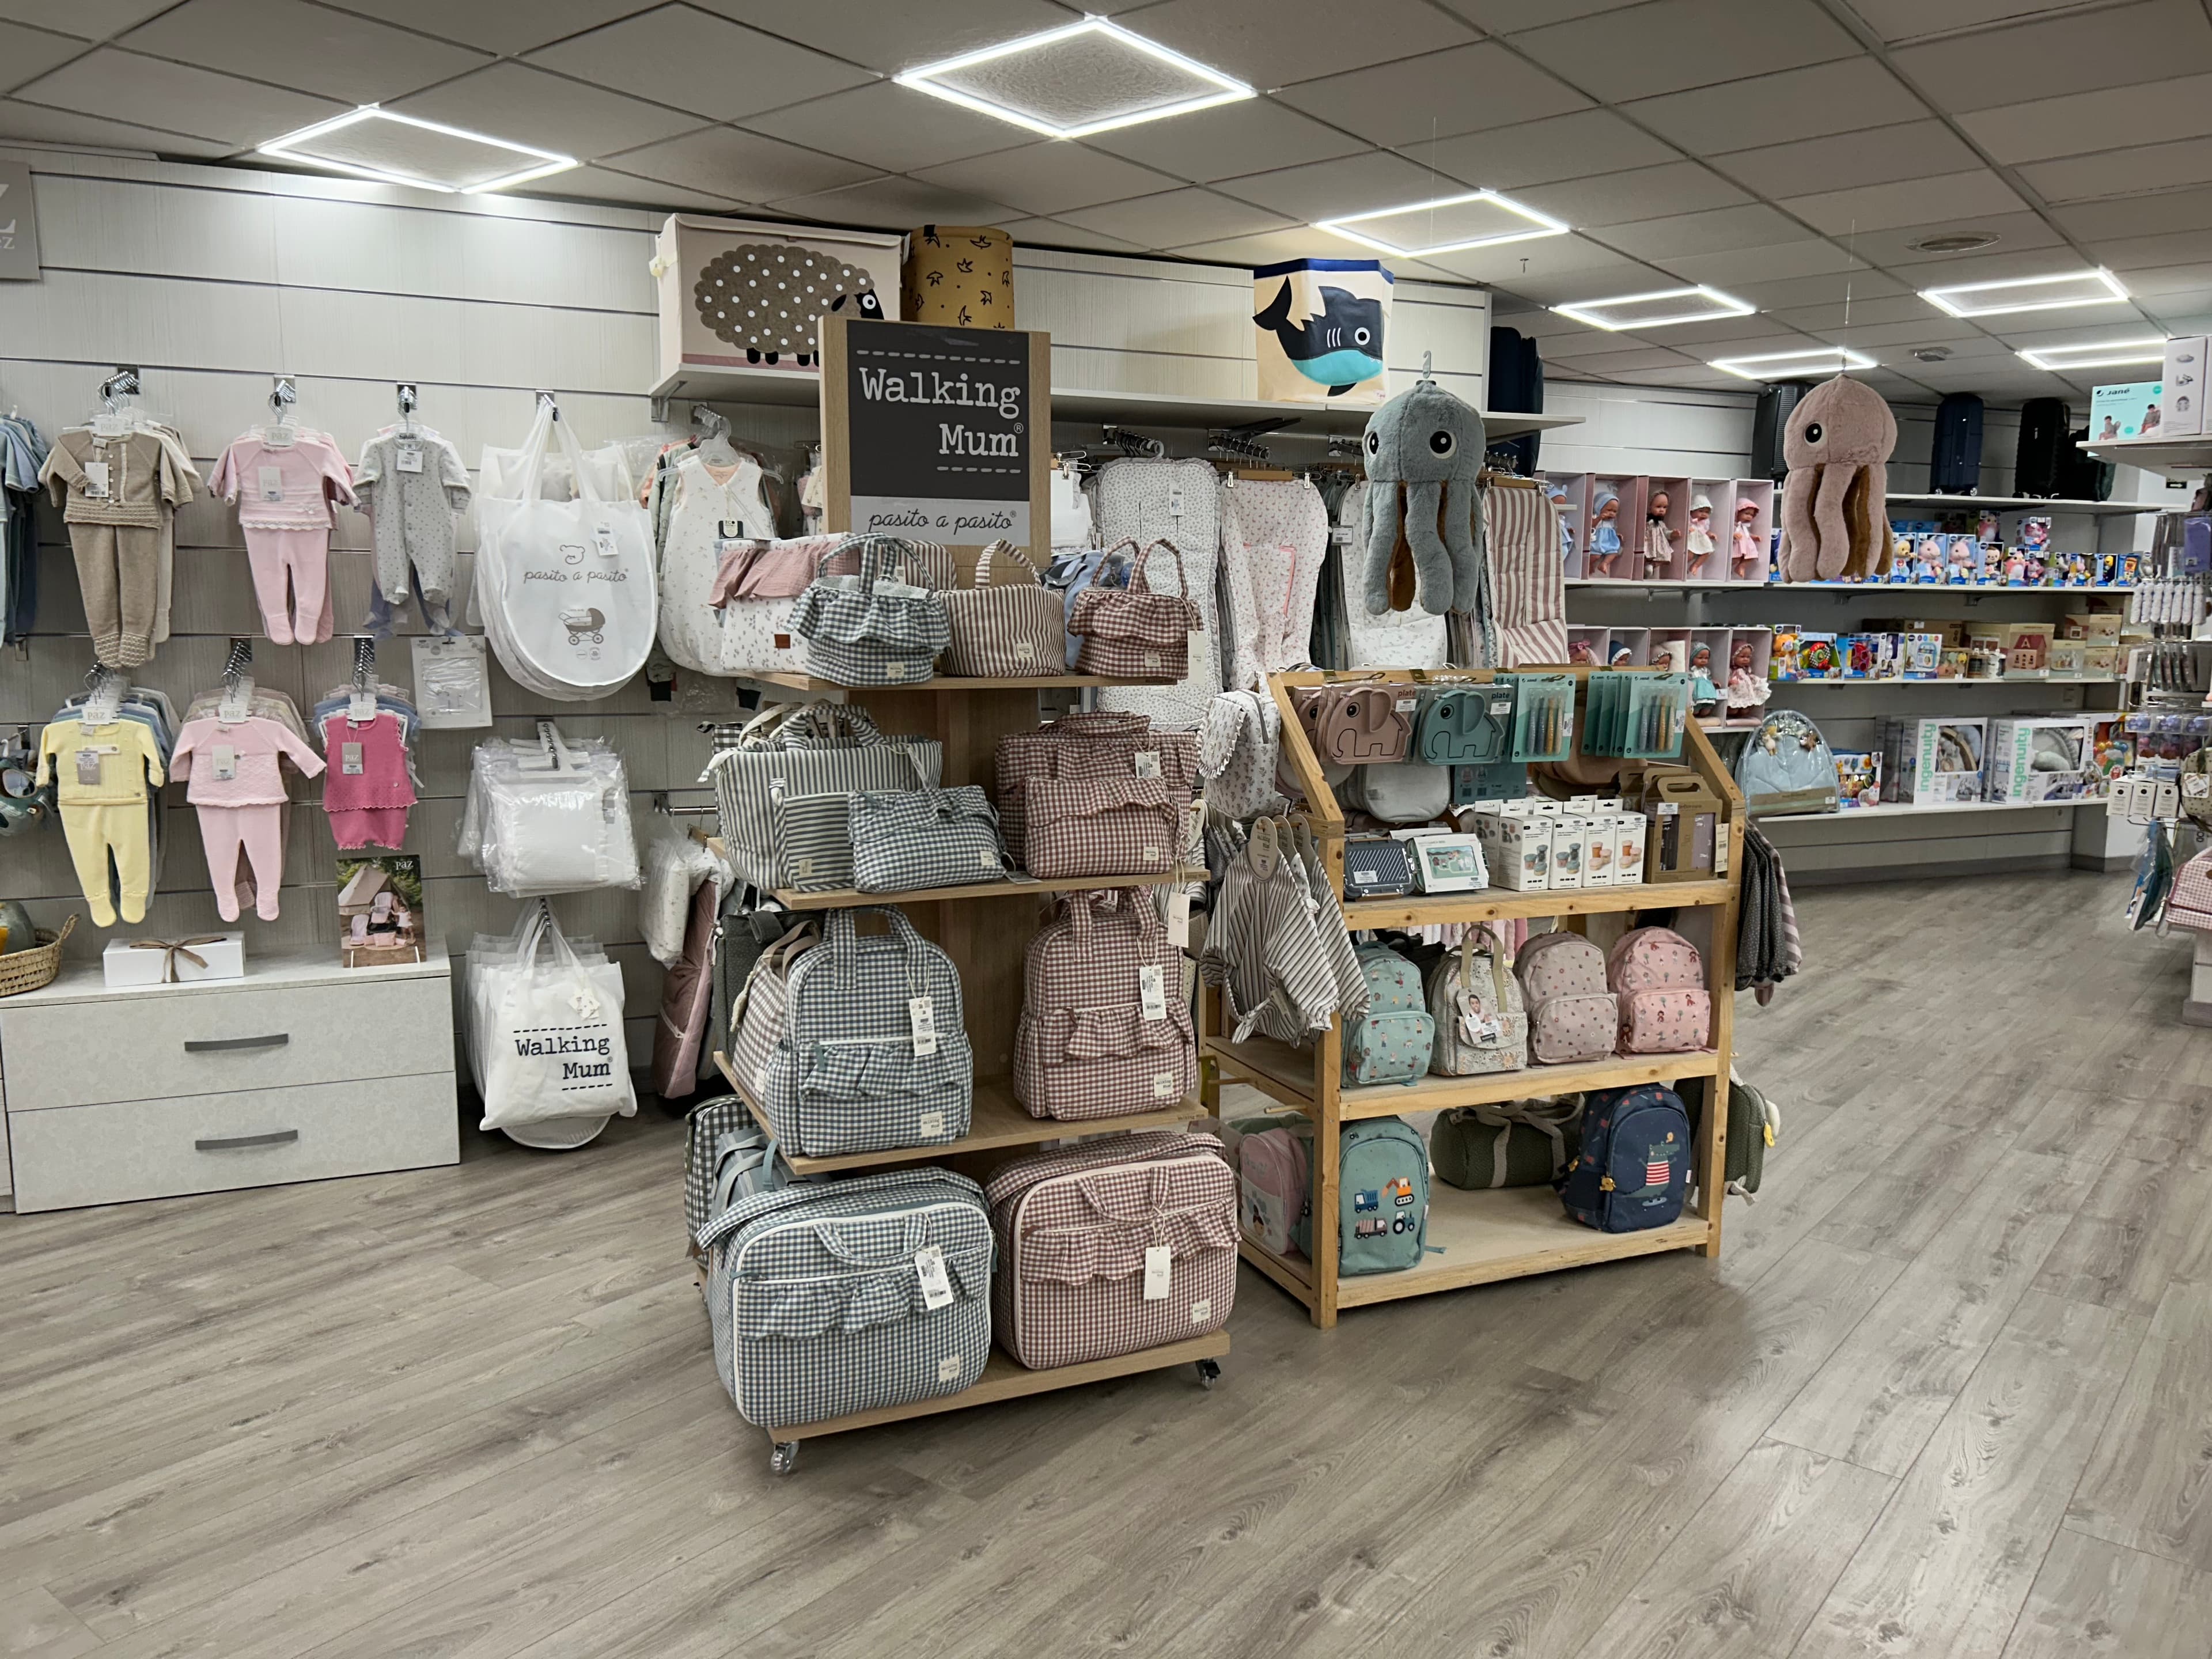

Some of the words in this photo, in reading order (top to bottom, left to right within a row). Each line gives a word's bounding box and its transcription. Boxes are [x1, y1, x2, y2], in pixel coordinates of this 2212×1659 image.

[859, 367, 1021, 419] Walking
[868, 508, 930, 533] pasito
[935, 516, 949, 528] a
[523, 569, 568, 584] pasito
[573, 571, 582, 581] a
[1397, 690, 1416, 698] plate
[87, 711, 106, 719] paz
[1917, 724, 1937, 792] ingenuity
[2009, 727, 2031, 797] ingenuity
[395, 861, 414, 870] paz
[514, 1036, 611, 1056] Walking
